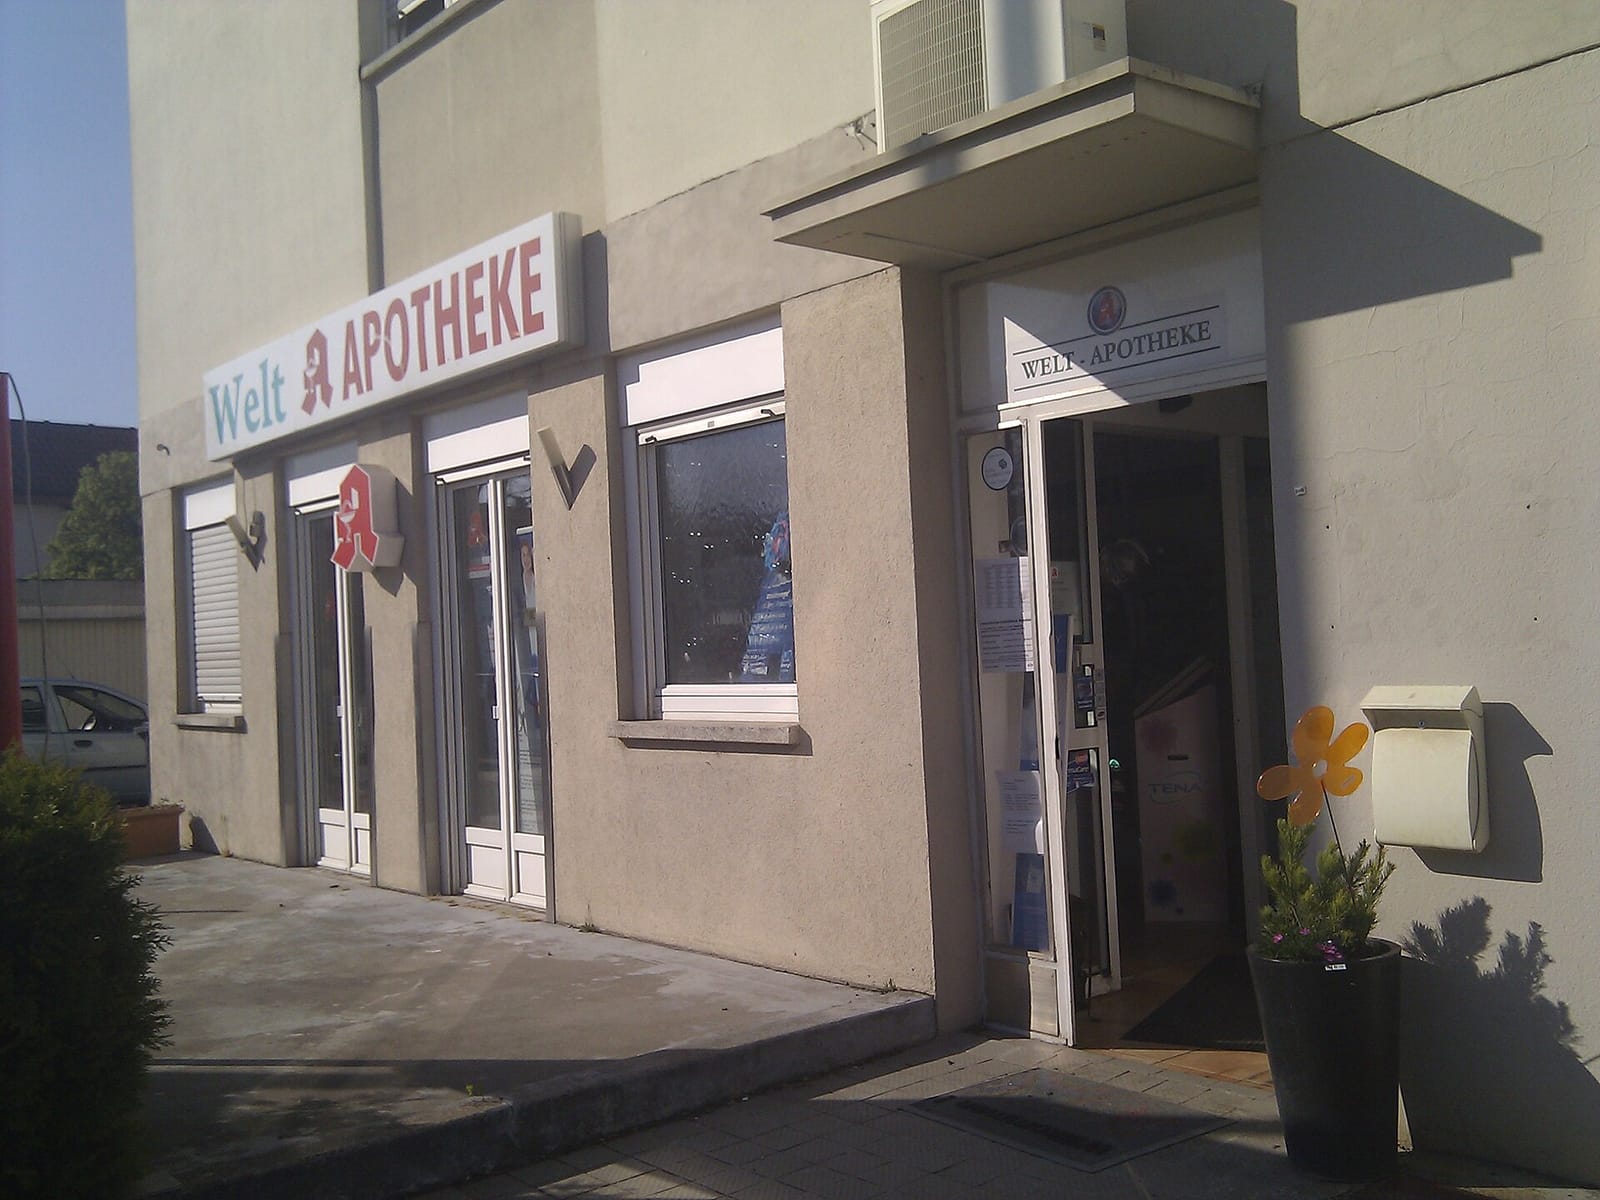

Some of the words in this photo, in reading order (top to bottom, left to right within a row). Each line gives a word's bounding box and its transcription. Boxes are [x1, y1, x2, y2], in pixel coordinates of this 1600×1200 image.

[209, 358, 286, 444] Welt
[343, 237, 544, 400] APOTHEKE
[1022, 352, 1075, 379] WELT
[1090, 320, 1212, 366] APOTHEKE
[1148, 783, 1202, 793] TENA
